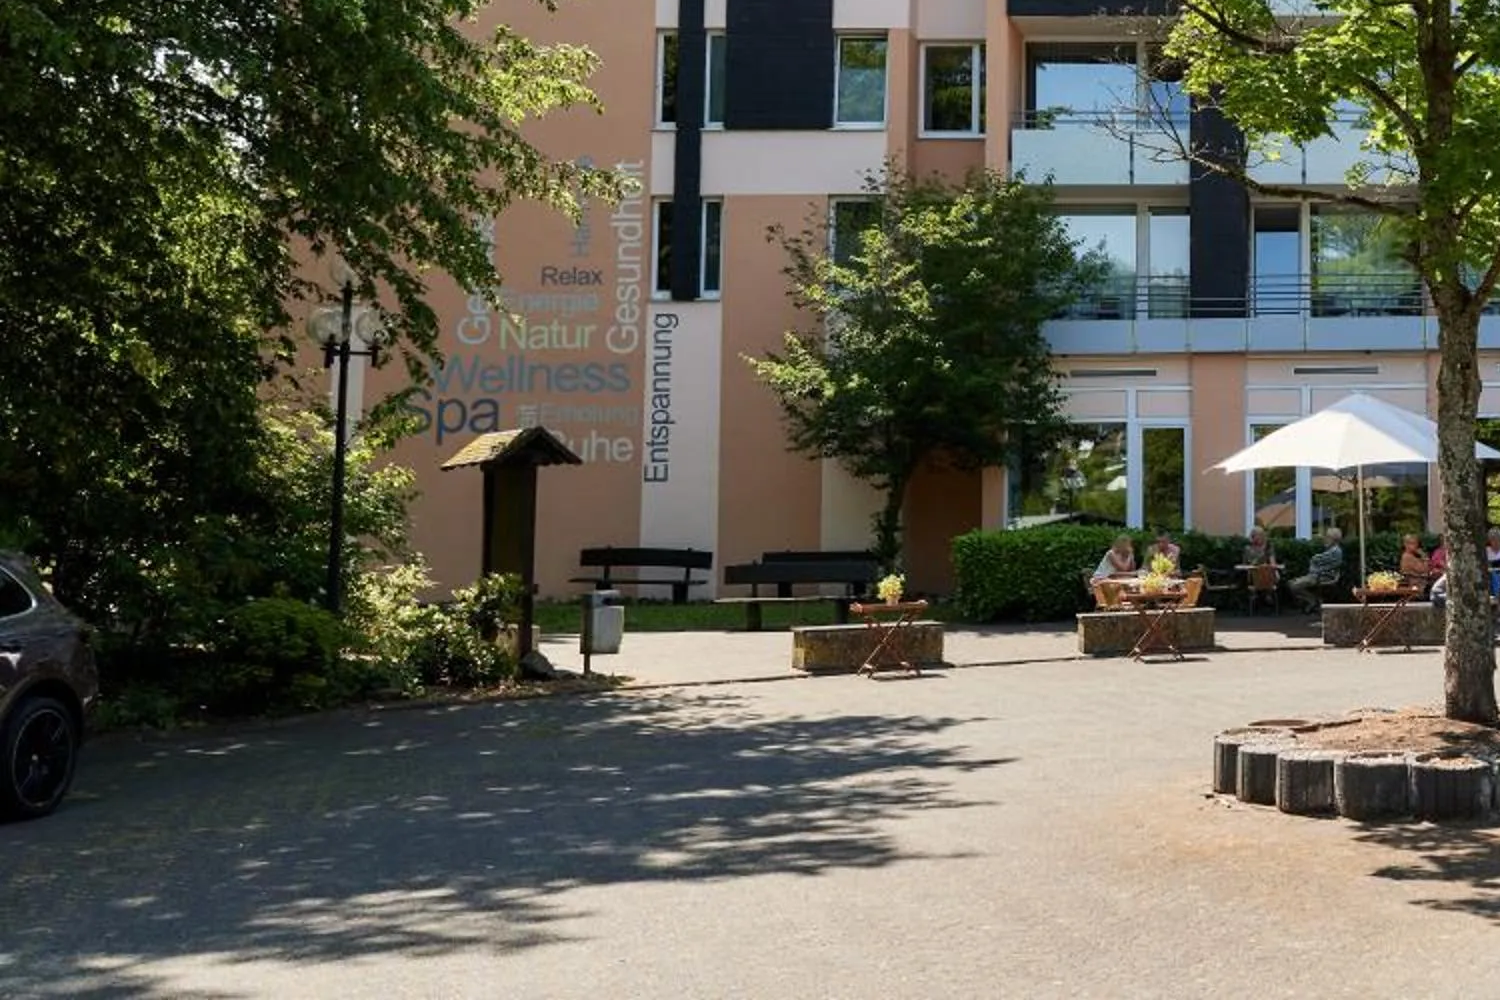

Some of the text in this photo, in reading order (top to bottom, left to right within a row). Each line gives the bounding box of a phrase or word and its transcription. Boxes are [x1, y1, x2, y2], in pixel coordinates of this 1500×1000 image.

[541, 267, 603, 286] Relax
[500, 317, 597, 351] Natur
[432, 354, 630, 394] Wellness
[402, 388, 499, 445] Spa
[644, 313, 679, 483] Entspannung
[549, 429, 633, 463] uhe
